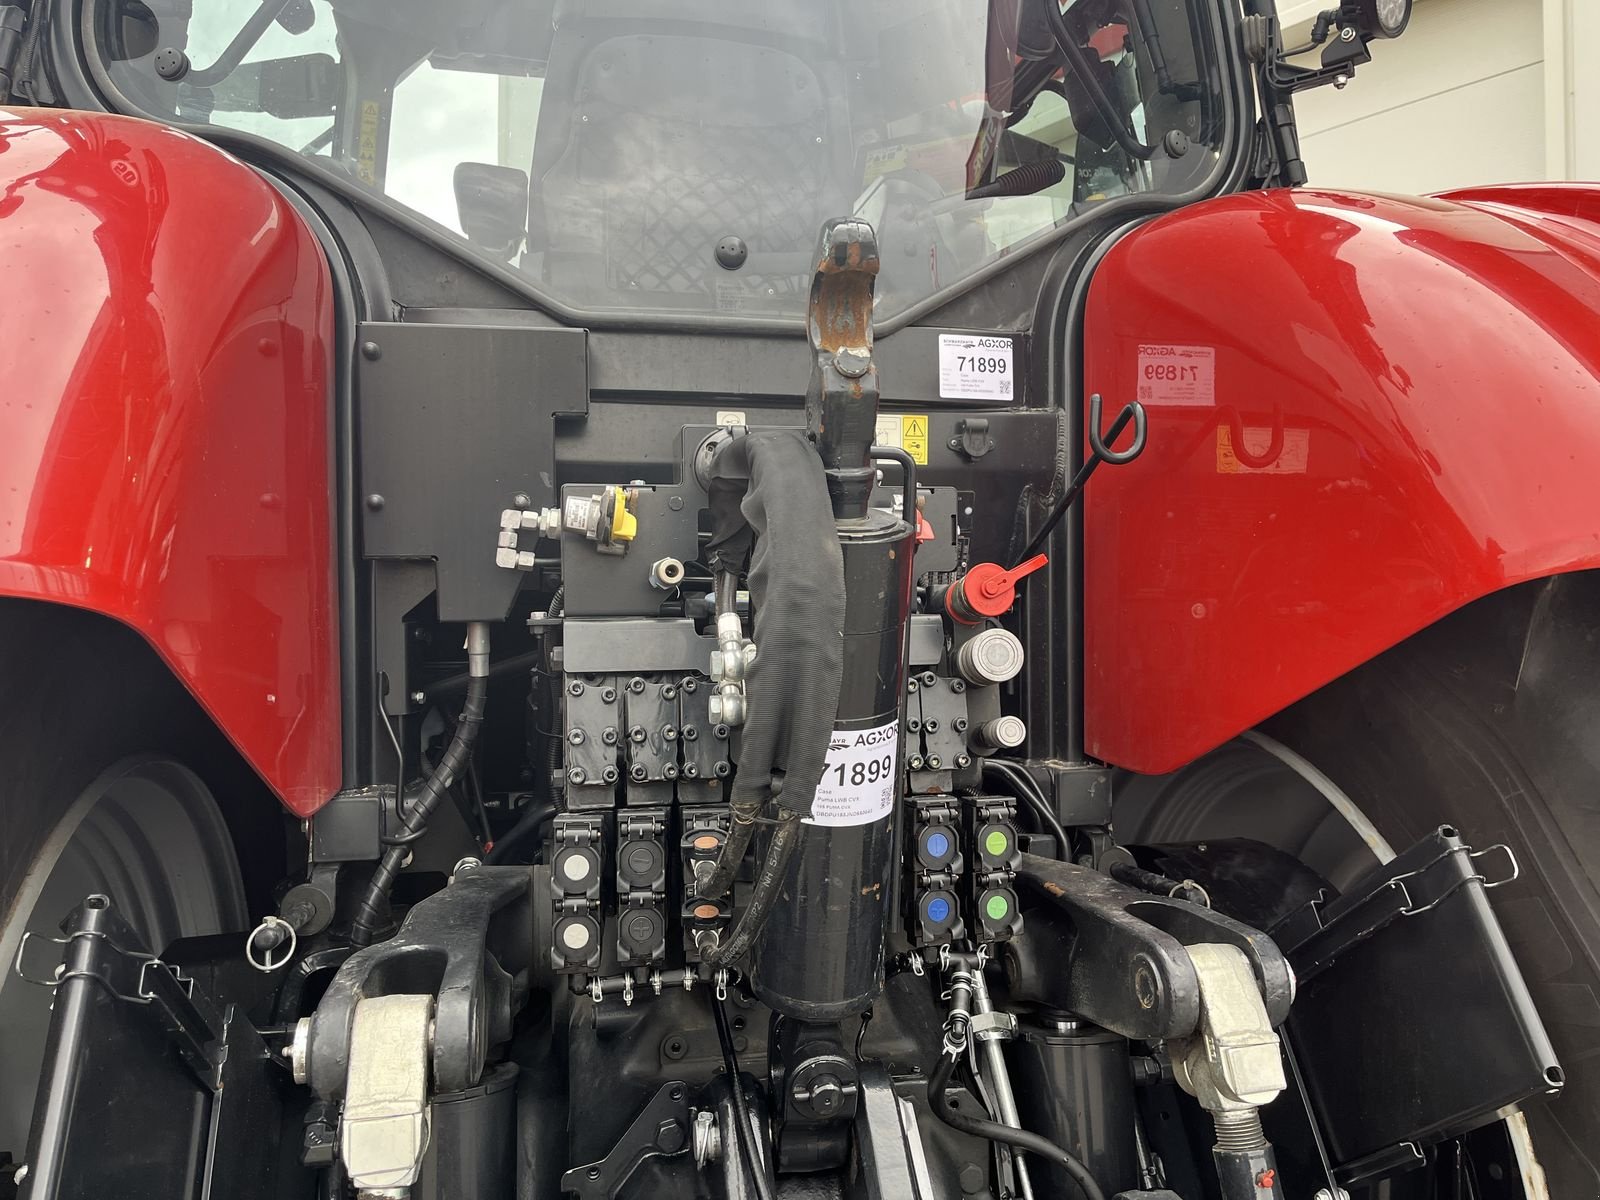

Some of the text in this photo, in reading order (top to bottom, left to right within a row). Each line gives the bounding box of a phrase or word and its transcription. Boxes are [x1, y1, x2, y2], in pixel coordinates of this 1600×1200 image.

[978, 338, 1014, 349] AGXOR
[957, 356, 1007, 374] 71899
[854, 722, 899, 747] AGXOR
[818, 755, 892, 787] 71899
